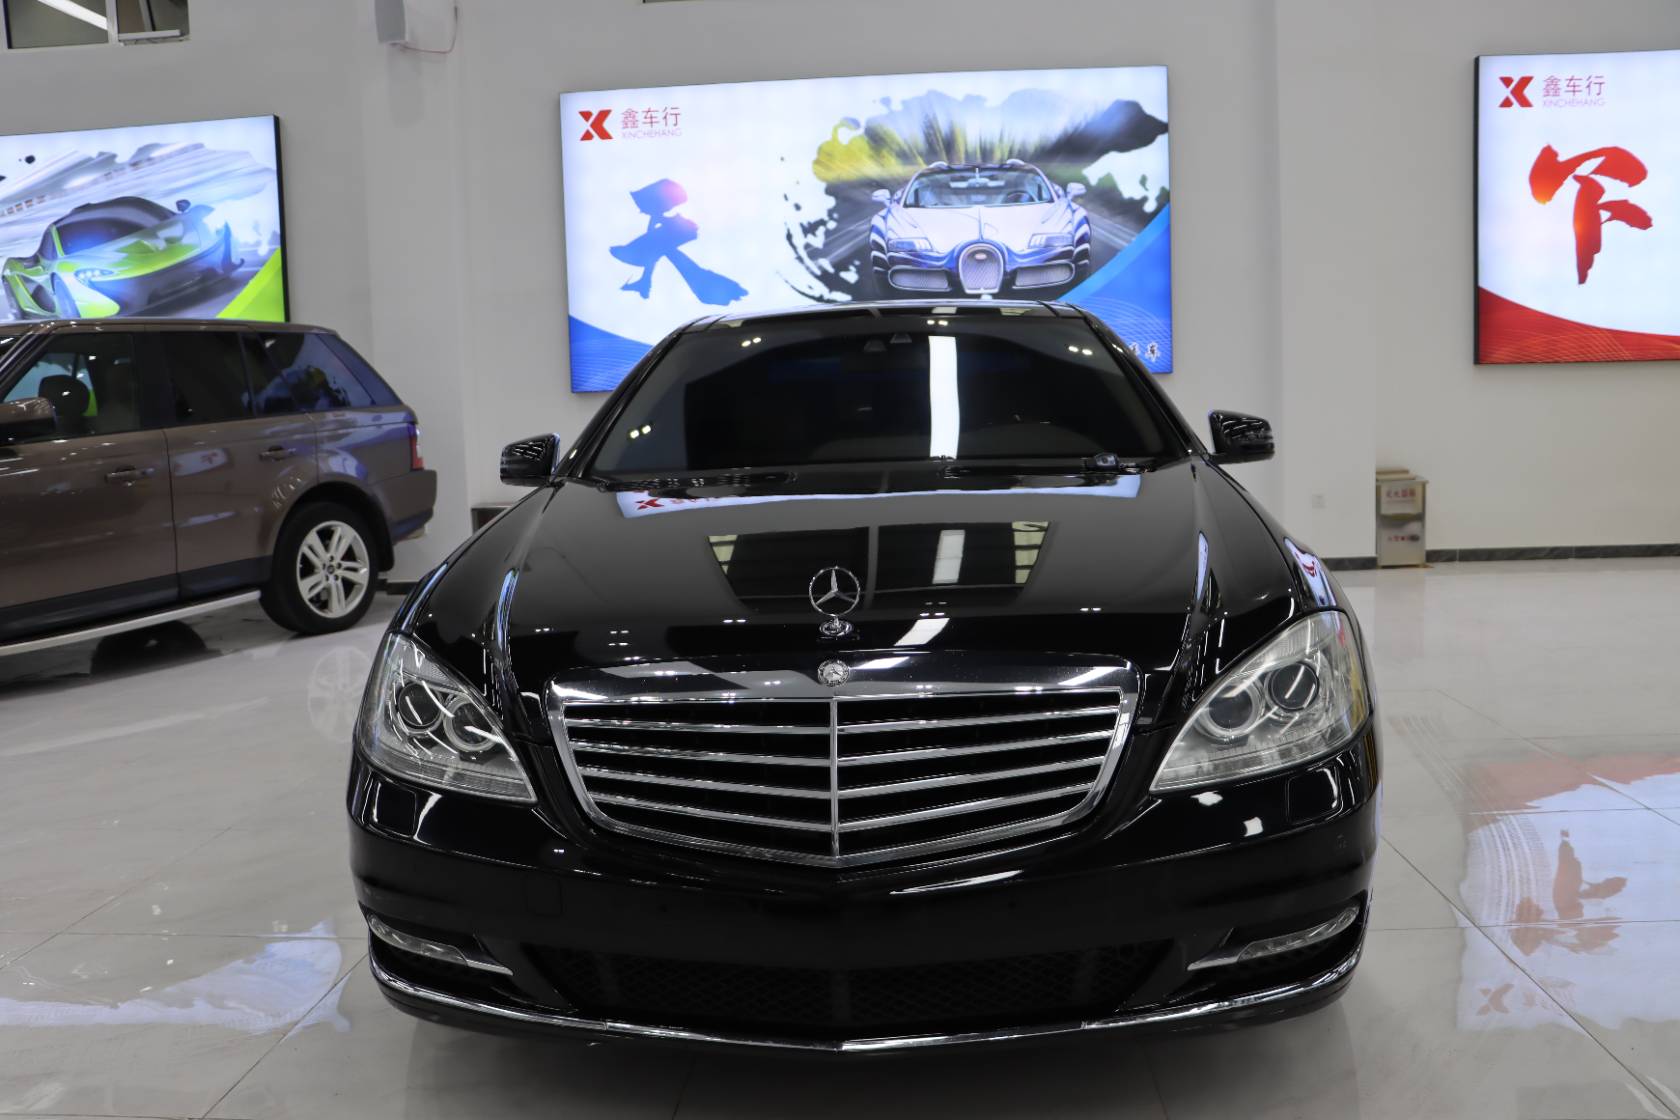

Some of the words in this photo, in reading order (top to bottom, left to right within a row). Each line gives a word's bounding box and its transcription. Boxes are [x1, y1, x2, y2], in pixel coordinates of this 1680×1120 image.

[1542, 75, 1606, 98] 鑫车行
[1542, 98, 1607, 108] XINCHEHANG
[620, 106, 681, 129] 鑫车行
[621, 128, 683, 139] XINCHEHANG
